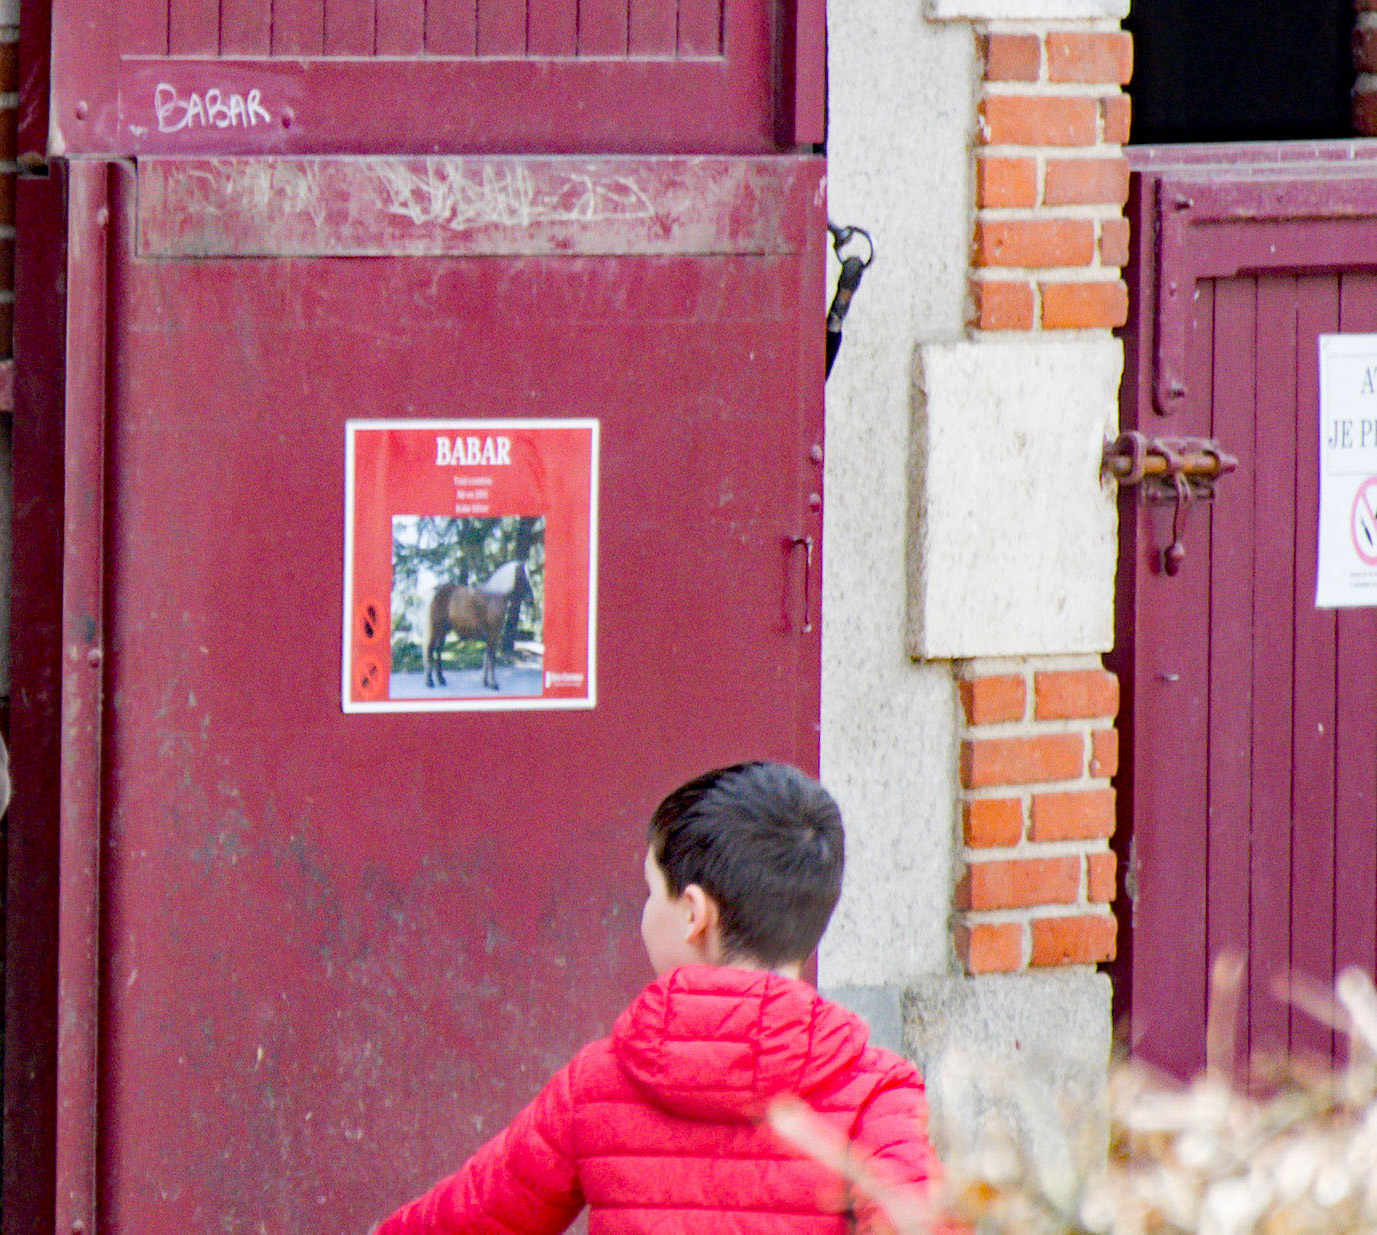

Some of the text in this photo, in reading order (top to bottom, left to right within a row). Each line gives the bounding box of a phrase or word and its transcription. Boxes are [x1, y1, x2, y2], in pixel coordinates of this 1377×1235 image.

[155, 82, 271, 133] BABAR
[1328, 419, 1353, 449] JE
[435, 436, 511, 466] BABAR
